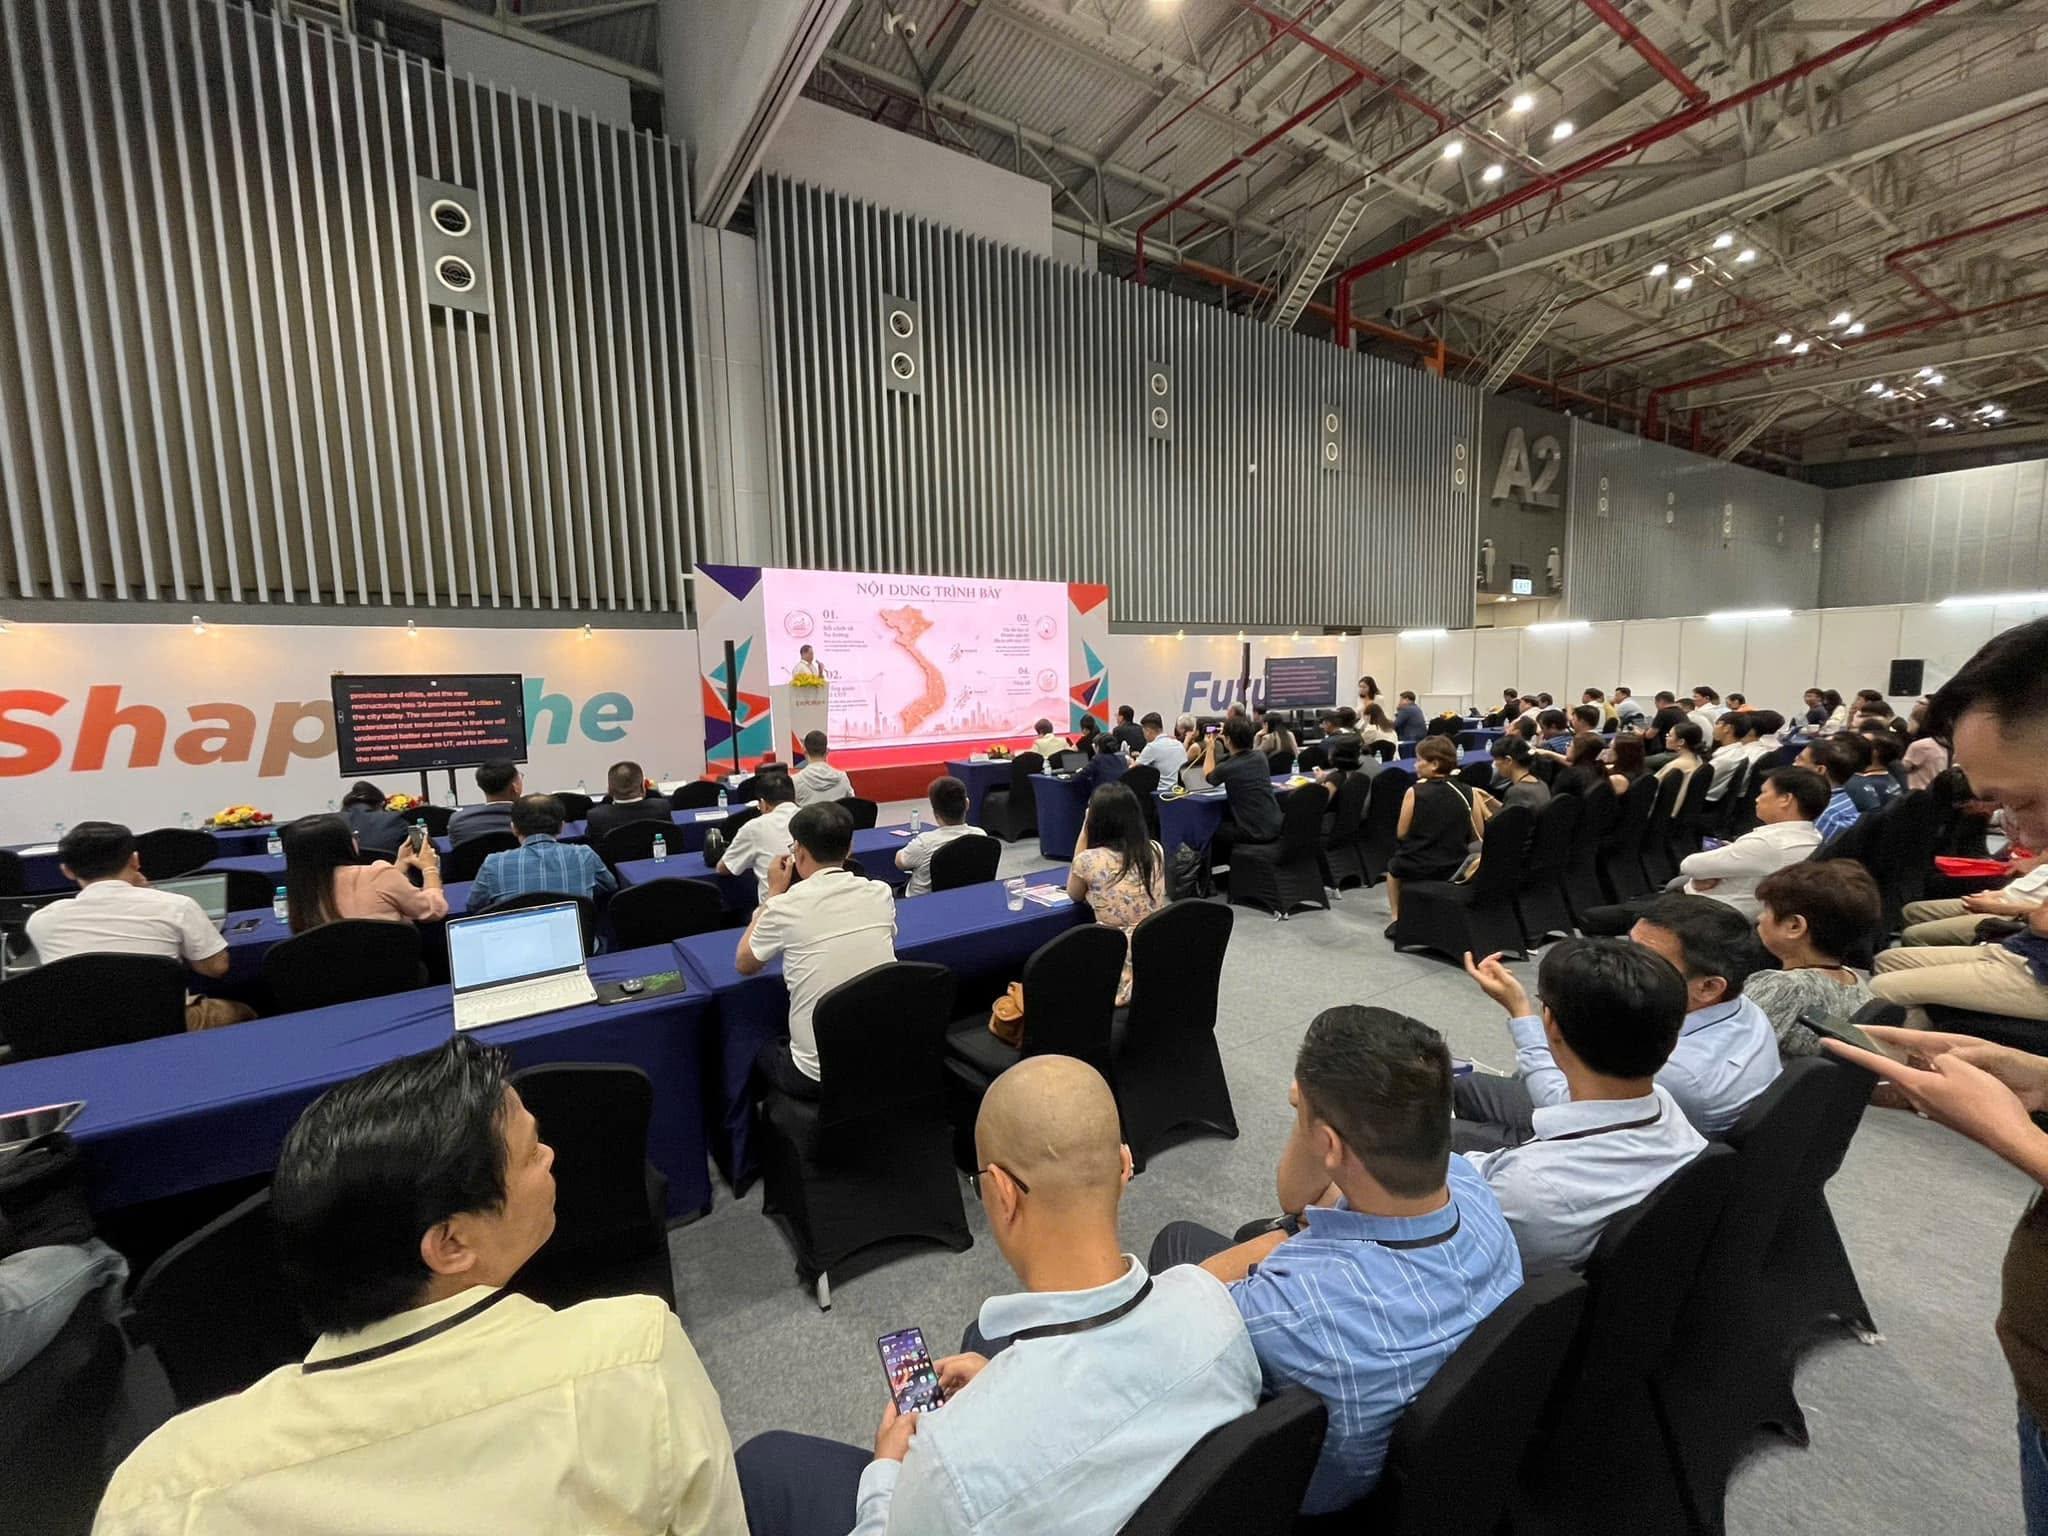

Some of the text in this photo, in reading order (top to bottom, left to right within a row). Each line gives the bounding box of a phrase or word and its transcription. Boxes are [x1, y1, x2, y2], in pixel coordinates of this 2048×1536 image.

[1491, 426, 1560, 509] A2
[856, 581, 1002, 599] NỘI DUNG TRÌNH BÀY
[823, 609, 838, 620] 01.
[367, 713, 381, 721] city
[0, 678, 634, 777] Shap he
[354, 734, 398, 742] understand
